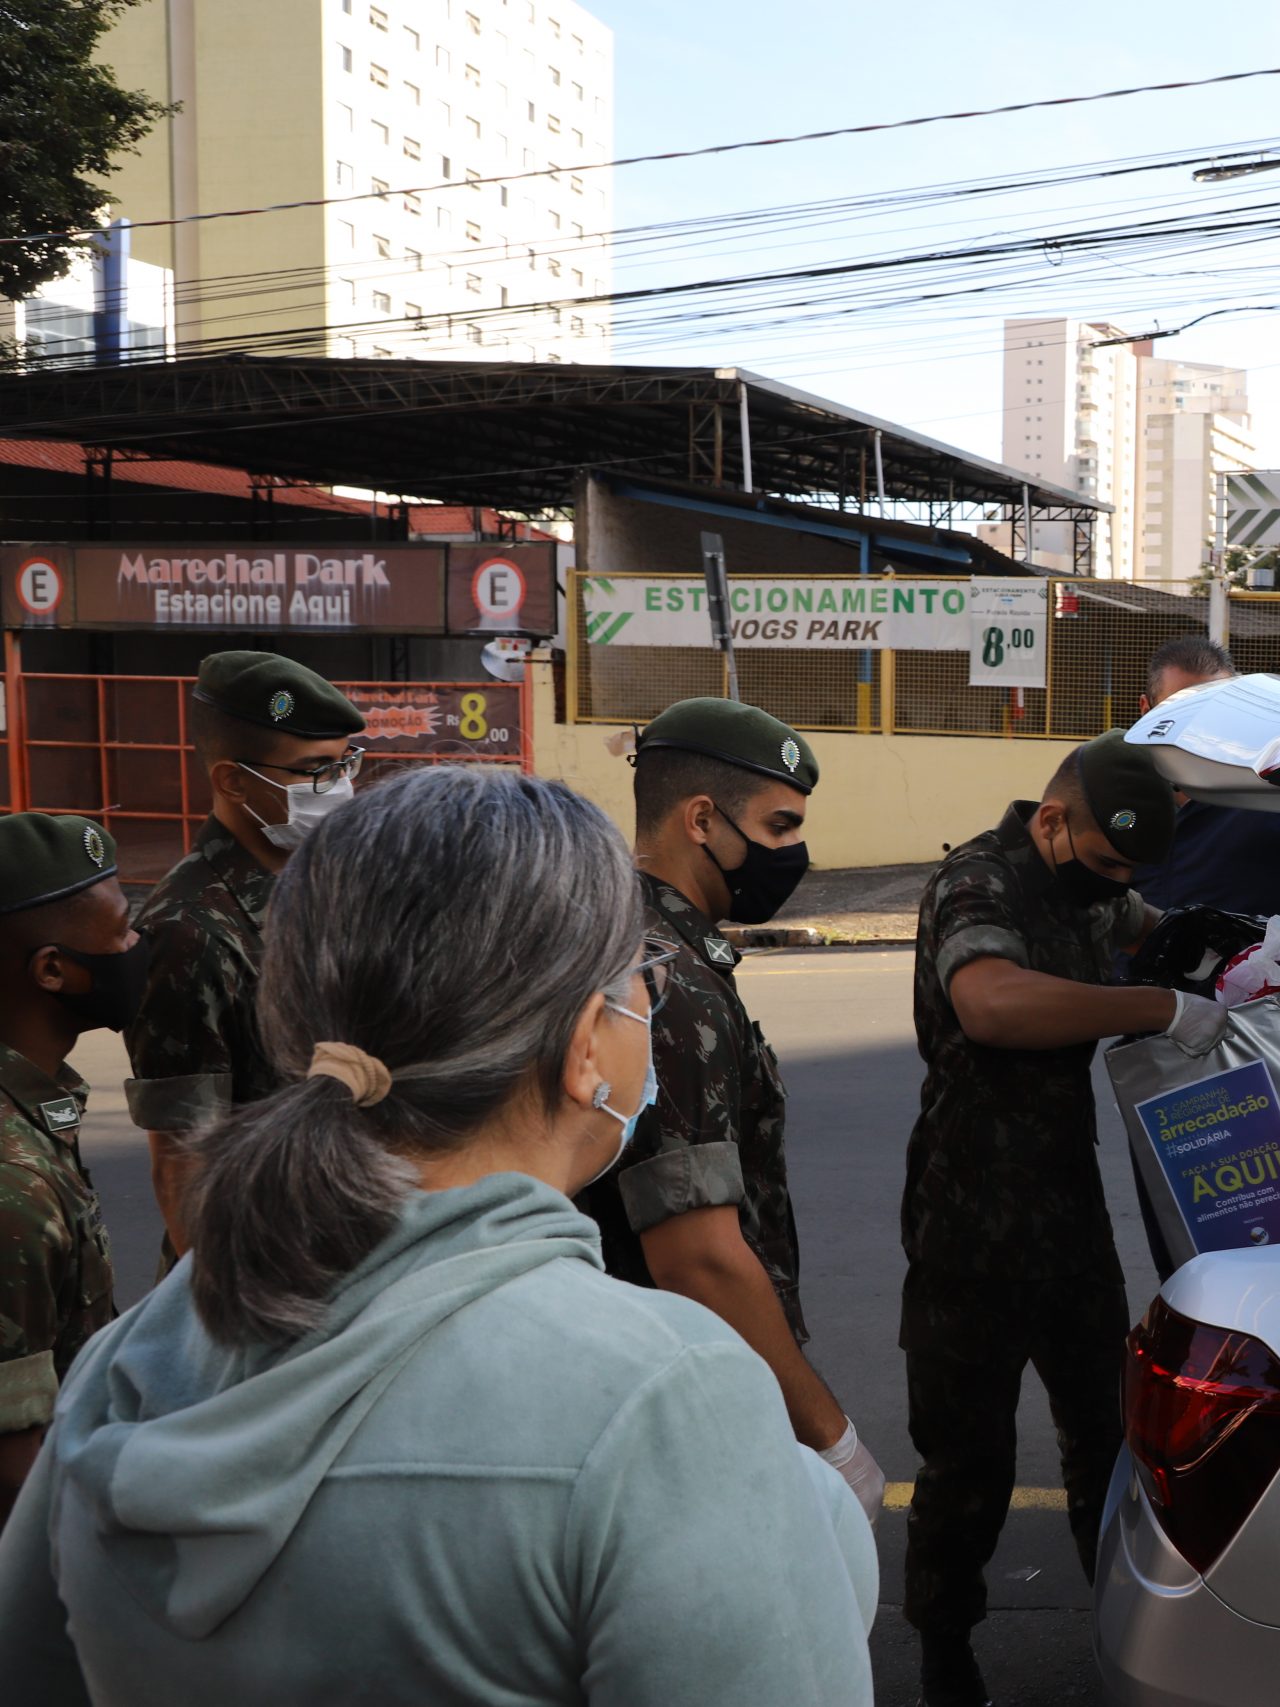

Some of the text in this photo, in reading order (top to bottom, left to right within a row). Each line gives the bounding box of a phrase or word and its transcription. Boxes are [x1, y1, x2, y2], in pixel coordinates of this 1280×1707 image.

[117, 553, 390, 585] Marechal Park
[31, 569, 49, 604] E
[488, 571, 509, 607] E
[155, 589, 350, 618] Estacione Aqui
[645, 587, 965, 614] ESTCIONAMENTO
[806, 619, 882, 641] PARK
[366, 715, 422, 729] ROMOÇÃO
[1171, 1094, 1231, 1120] REGIONAL DE
[1173, 1087, 1229, 1111] CAMPANHA
[1160, 1094, 1269, 1141] arrecadação
[1182, 1142, 1279, 1178] FAÇA A SUA DOAÇÃO
[1215, 1186, 1275, 1208] Contribua com
[1197, 1205, 1238, 1223] alimentos
[1240, 1199, 1254, 1210] não
